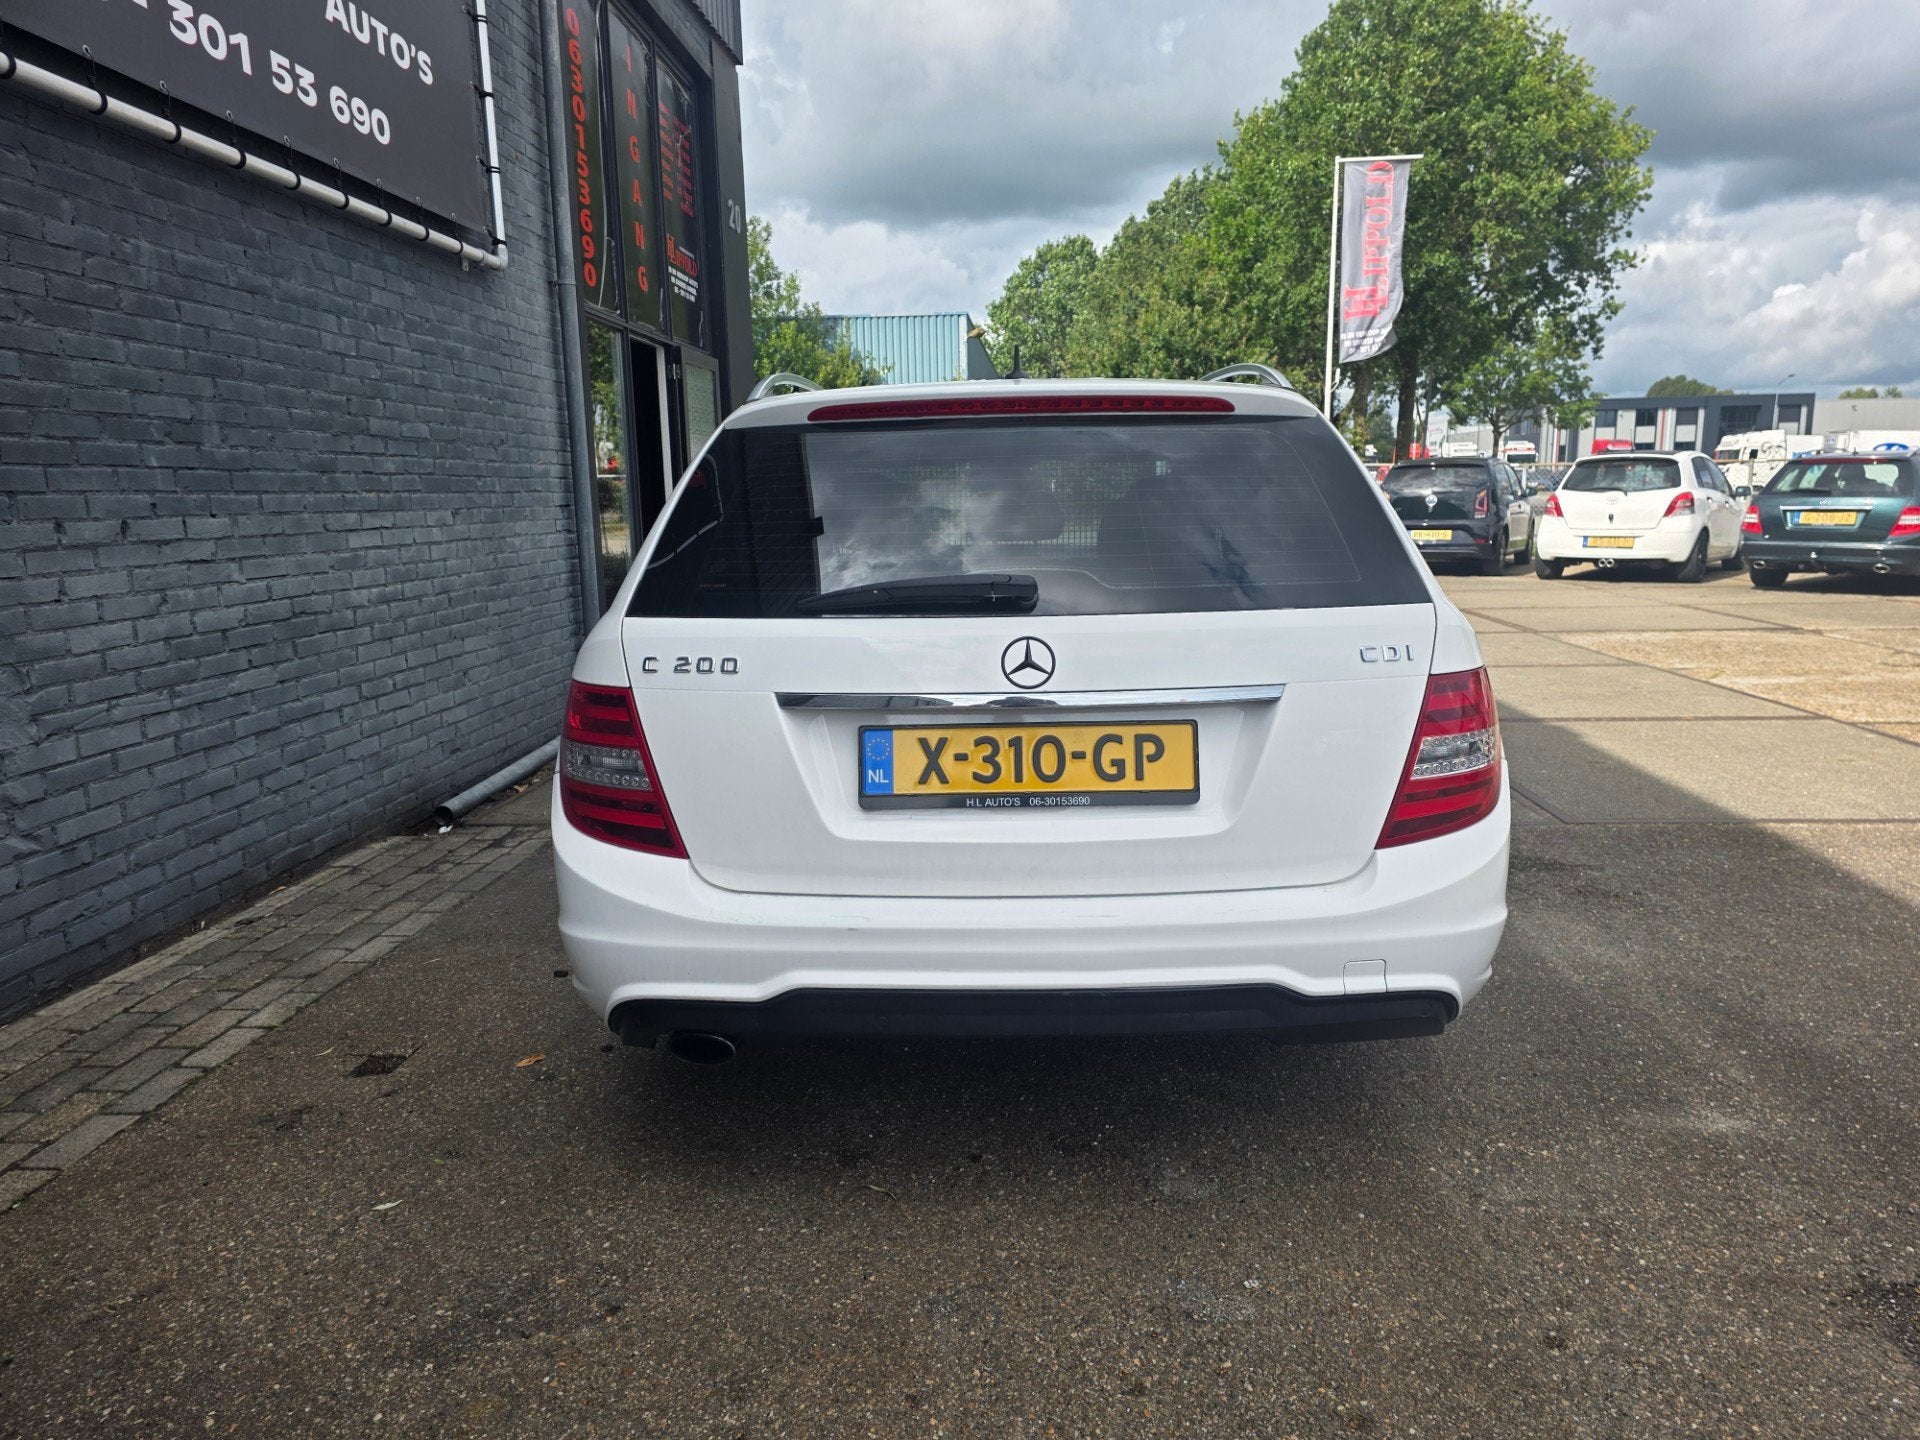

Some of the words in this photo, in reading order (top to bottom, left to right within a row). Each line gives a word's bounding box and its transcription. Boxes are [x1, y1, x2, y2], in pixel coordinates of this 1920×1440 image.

[325, 0, 434, 86] AUTO'S
[167, 0, 253, 76] 301
[269, 49, 318, 108] 53
[329, 86, 391, 146] 690
[566, 7, 597, 288] 0630153690
[625, 45, 649, 293] INGANG
[727, 198, 741, 235] 20
[642, 656, 659, 674] C
[673, 656, 740, 675] 200
[1360, 644, 1414, 663] CDI
[868, 768, 890, 784] NL
[917, 733, 1166, 785] X-310-GP
[984, 797, 1021, 807] AUTO'S
[1029, 796, 1091, 806] 06-30153690
